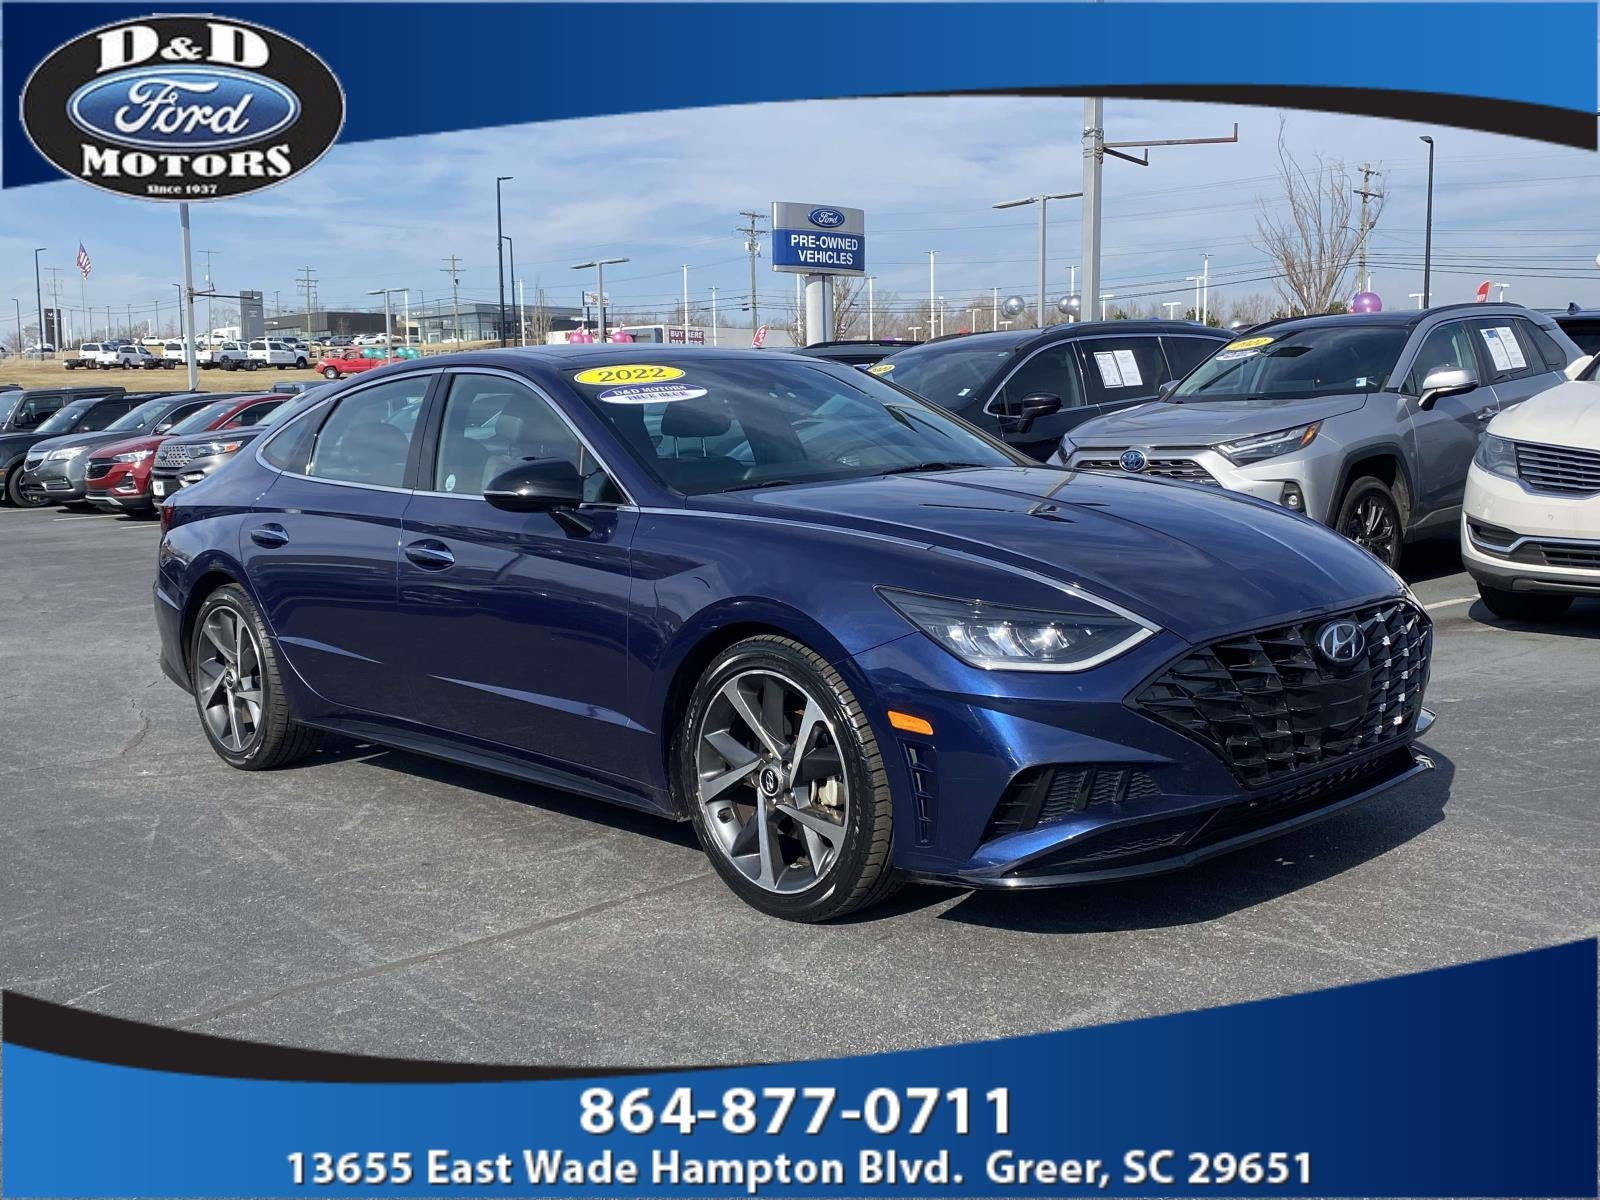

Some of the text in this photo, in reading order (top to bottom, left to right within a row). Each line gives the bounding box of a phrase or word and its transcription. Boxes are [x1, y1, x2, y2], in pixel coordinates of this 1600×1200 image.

[818, 211, 838, 224] Ford
[790, 234, 858, 251] PRE-OWNED
[798, 250, 853, 265] VEHICLES
[670, 330, 684, 338] BUY
[598, 368, 667, 382] 2022
[613, 385, 687, 396] D&D MOTORS
